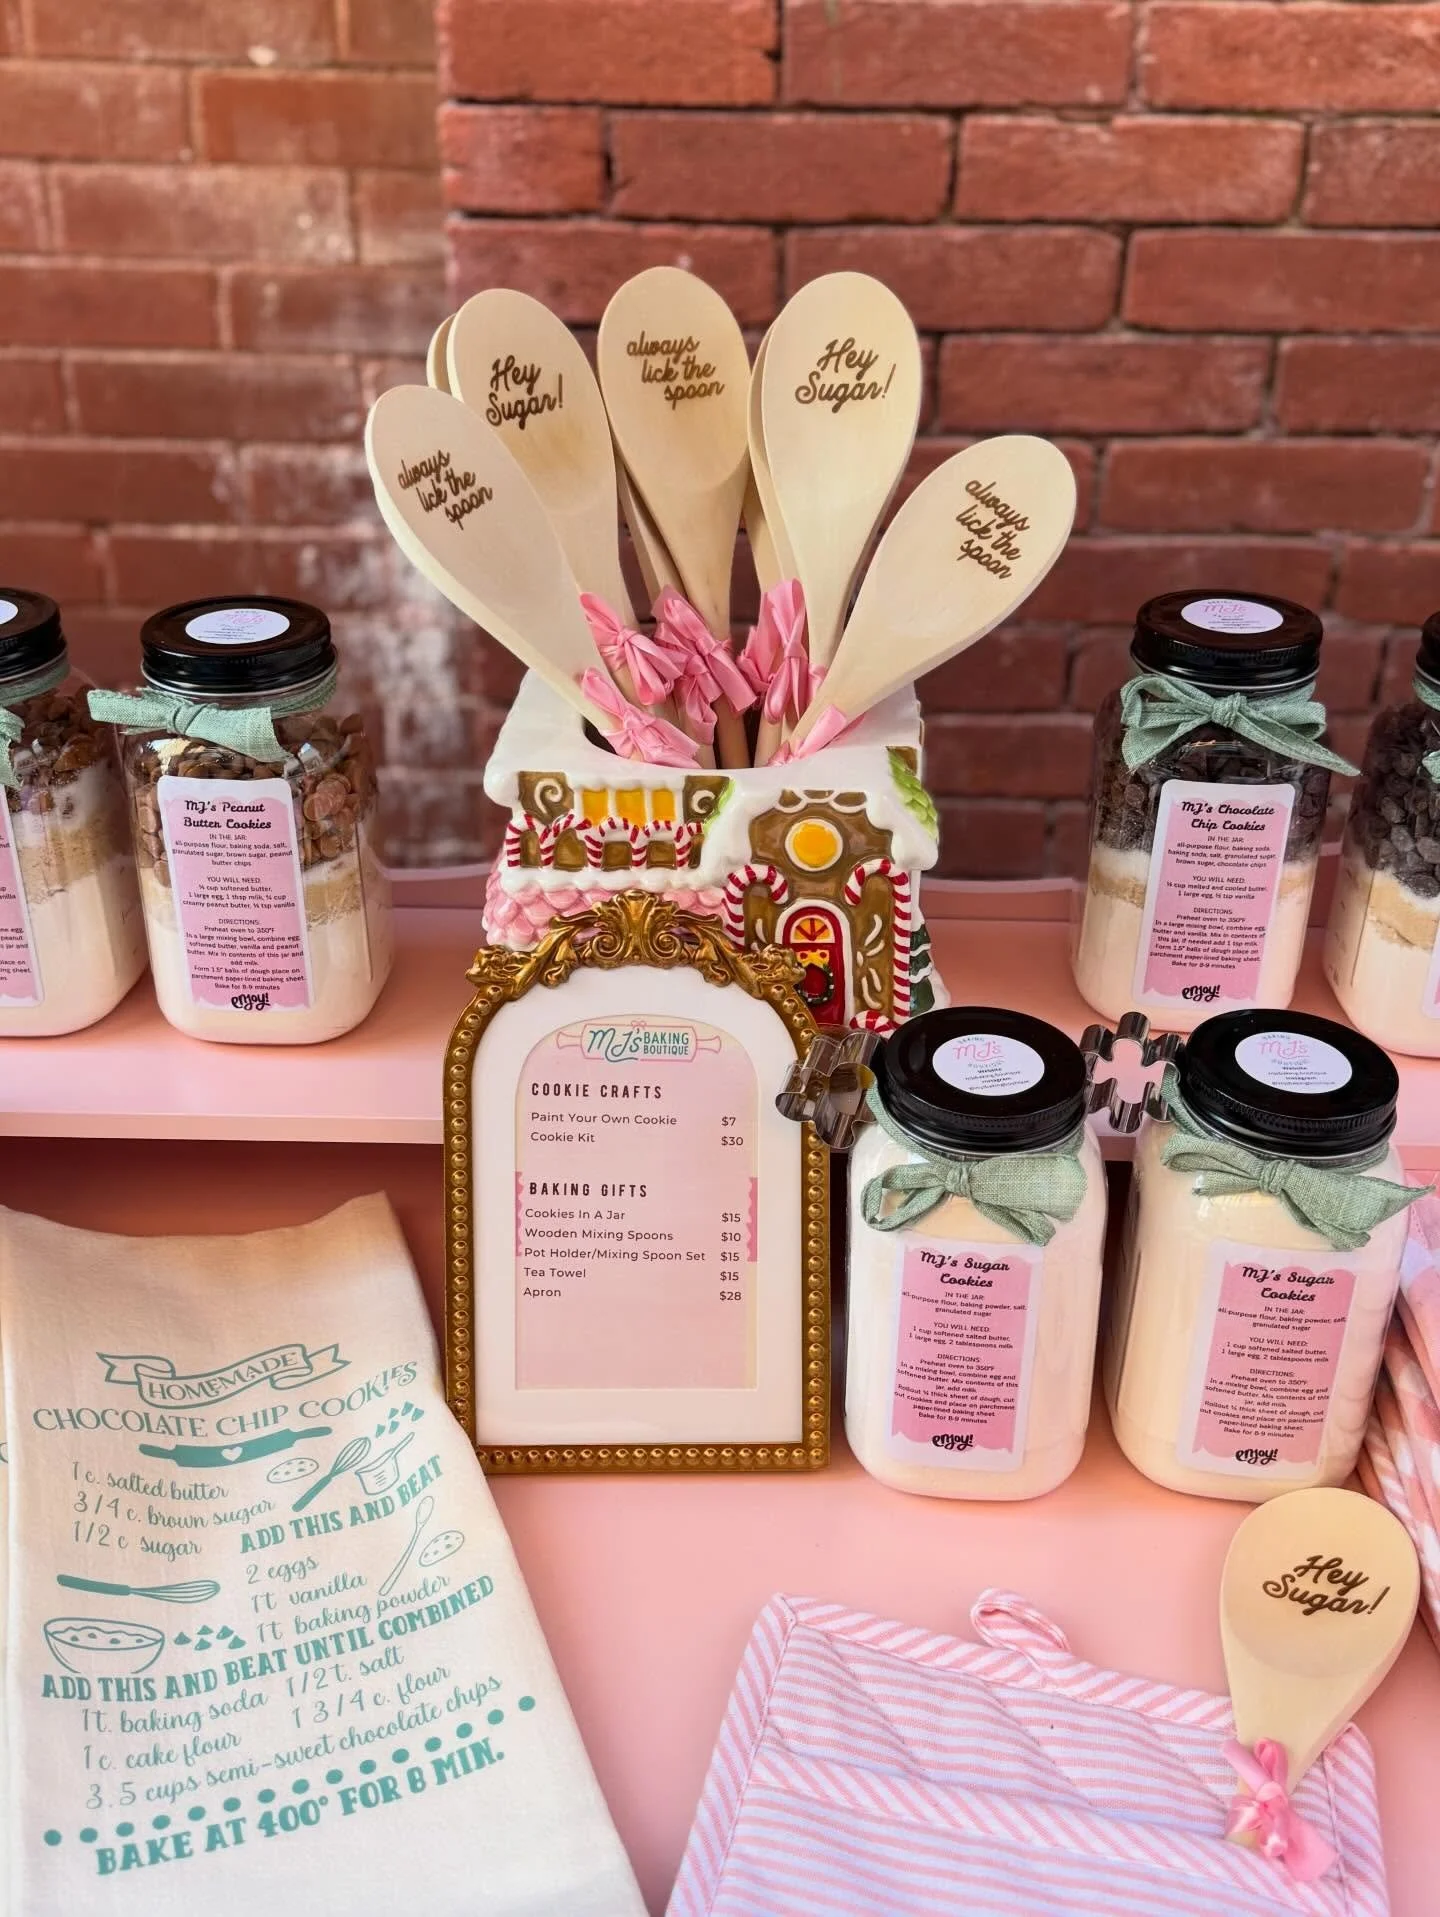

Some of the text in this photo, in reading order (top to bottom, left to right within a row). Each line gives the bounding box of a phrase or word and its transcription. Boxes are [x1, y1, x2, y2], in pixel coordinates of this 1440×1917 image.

[626, 331, 700, 364] always
[817, 337, 879, 381] Hey
[490, 354, 541, 394] Hey
[642, 356, 716, 384] lick the
[485, 373, 563, 430] Sugar!
[664, 382, 725, 410] spoon
[794, 363, 897, 413] Sugar!
[398, 450, 450, 489] always
[416, 468, 476, 512] lick the
[446, 486, 493, 530] spoon
[964, 479, 1030, 532] always
[955, 504, 1021, 561] lick the
[957, 537, 1012, 579] spoon
[185, 800, 265, 814] MJ's Peanut
[1181, 801, 1275, 815] MJ's Chocolate
[184, 817, 272, 829] Butter Cookies
[1191, 819, 1266, 831] Chip Cookies
[263, 975, 284, 983] baking
[1182, 984, 1221, 1002] enjoy!
[231, 992, 271, 1011] enjoy!
[587, 1027, 689, 1063] MJ's BAKING
[643, 1044, 689, 1056] BOUTIQUE
[531, 1083, 662, 1099] COOKIE CRAFTS
[531, 1112, 736, 1127] Paint Your Own Cookie $7
[531, 1132, 744, 1147] Cookie Kit $30
[529, 1182, 647, 1198] BAKING GIFTS
[525, 1208, 741, 1224] Cookies In A Jar $15
[525, 1228, 742, 1243] Wooden Mixing Spoons $10
[525, 1247, 740, 1263] Pot Holder/Mixing Spoon Set $15
[921, 1250, 1010, 1273] MJ's Sugar
[524, 1267, 739, 1282] Tea Towel $15
[940, 1273, 993, 1288] Cookies
[1242, 1266, 1335, 1287] MJ's Sugar
[523, 1287, 742, 1302] Apron $28
[1261, 1288, 1316, 1302] Cookies
[935, 1306, 992, 1318] granulated sugar
[1252, 1321, 1311, 1332] granulated sugar
[1250, 1336, 1265, 1344] YOU
[1267, 1338, 1285, 1346] WILL
[149, 1352, 298, 1400] HOMEMADE
[32, 1407, 209, 1437] CHOCOLATE
[215, 1404, 289, 1436] CHIP
[919, 1412, 935, 1420] Bake
[932, 1433, 974, 1451] enjoy!
[1235, 1448, 1279, 1465] enjoy!
[72, 1461, 229, 1501] 1 c. salted butter
[127, 1508, 142, 1523] c.
[148, 1504, 209, 1529] brown
[213, 1499, 276, 1526] sugar
[240, 1454, 444, 1554] ADD THIS AND BEAT
[139, 1535, 202, 1562] sugar
[246, 1556, 319, 1585] 2 eggs
[1293, 1554, 1370, 1596] Hey
[289, 1572, 368, 1606] vanilla
[1262, 1574, 1391, 1616] Sugar!
[294, 1601, 373, 1635] baking
[375, 1575, 451, 1618] powder
[41, 1575, 495, 1702] ADD THIS AND BEAT UNTIL COMBINED
[359, 1646, 405, 1677] salt
[120, 1709, 202, 1734] baking
[209, 1688, 269, 1720] soda
[292, 1707, 301, 1729] 1
[373, 1691, 390, 1707] c.
[397, 1667, 451, 1705] flour
[83, 1732, 242, 1770] 1 c. cake flour
[146, 1775, 201, 1804] cups
[206, 1733, 336, 1786] semi-sweet
[339, 1703, 442, 1751] chocolate
[447, 1675, 502, 1713] chips
[96, 1737, 505, 1875] BAKE AT 400° FOR 8 MIN.
